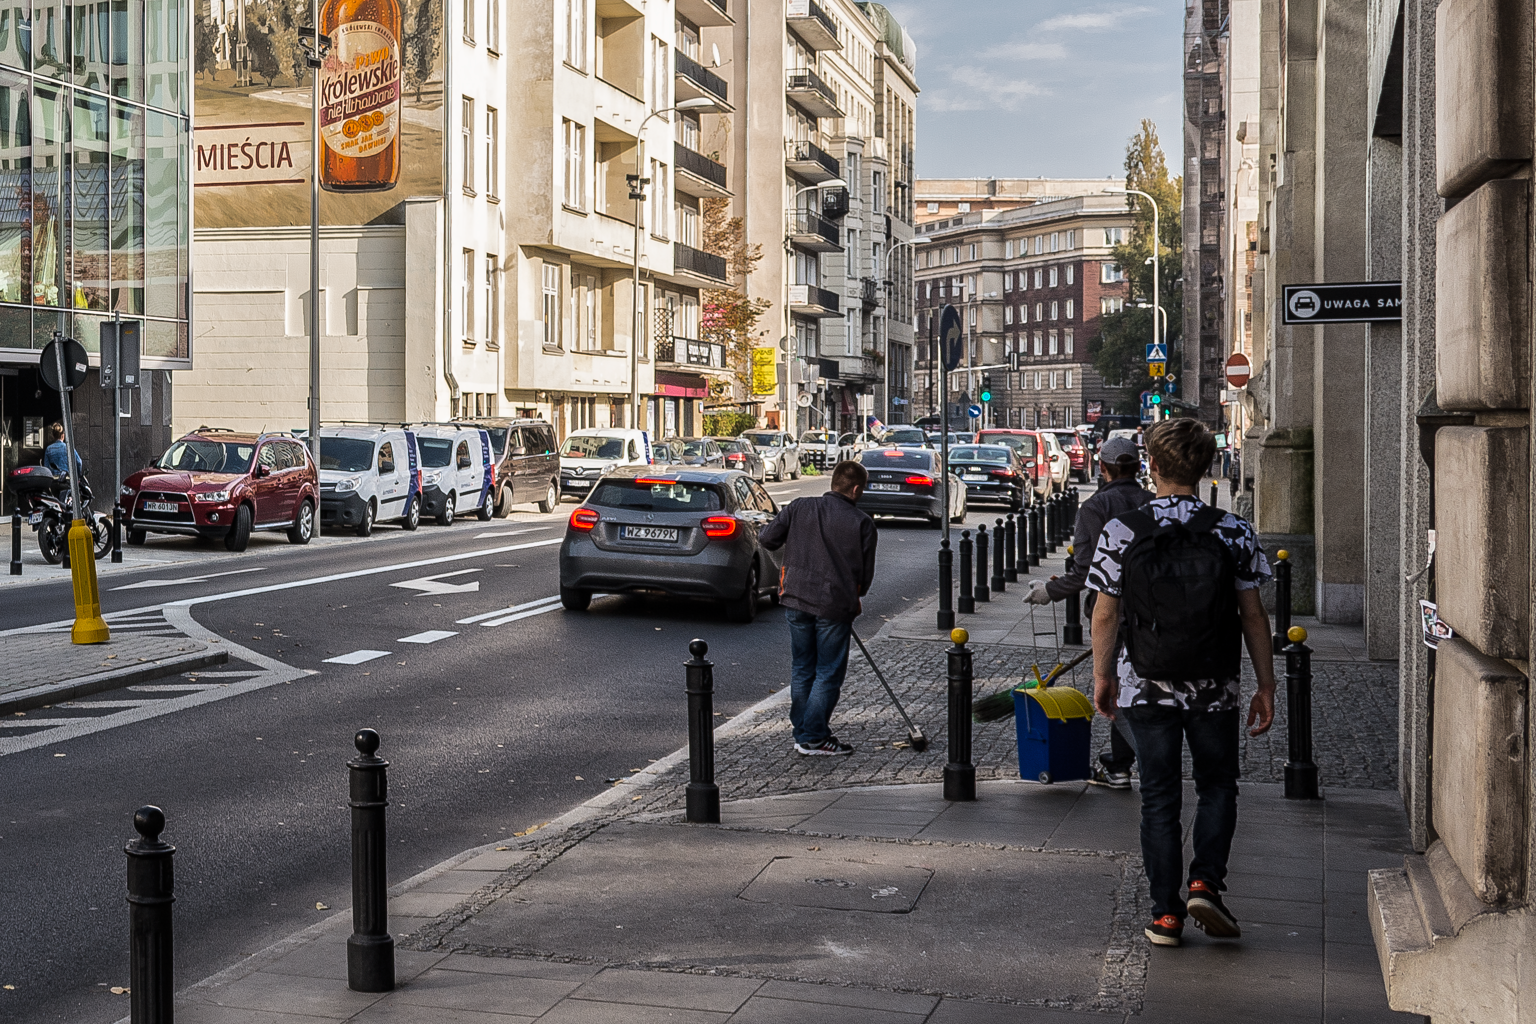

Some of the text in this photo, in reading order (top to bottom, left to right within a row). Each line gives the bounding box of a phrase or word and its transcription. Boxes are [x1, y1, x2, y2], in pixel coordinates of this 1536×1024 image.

[321, 54, 398, 107] Królewskie
[340, 133, 373, 150] SMAK JAK
[358, 137, 386, 153] DAWNIEJ
[1324, 299, 1371, 309] UWAGA
[627, 527, 675, 539] WZ 9679K
